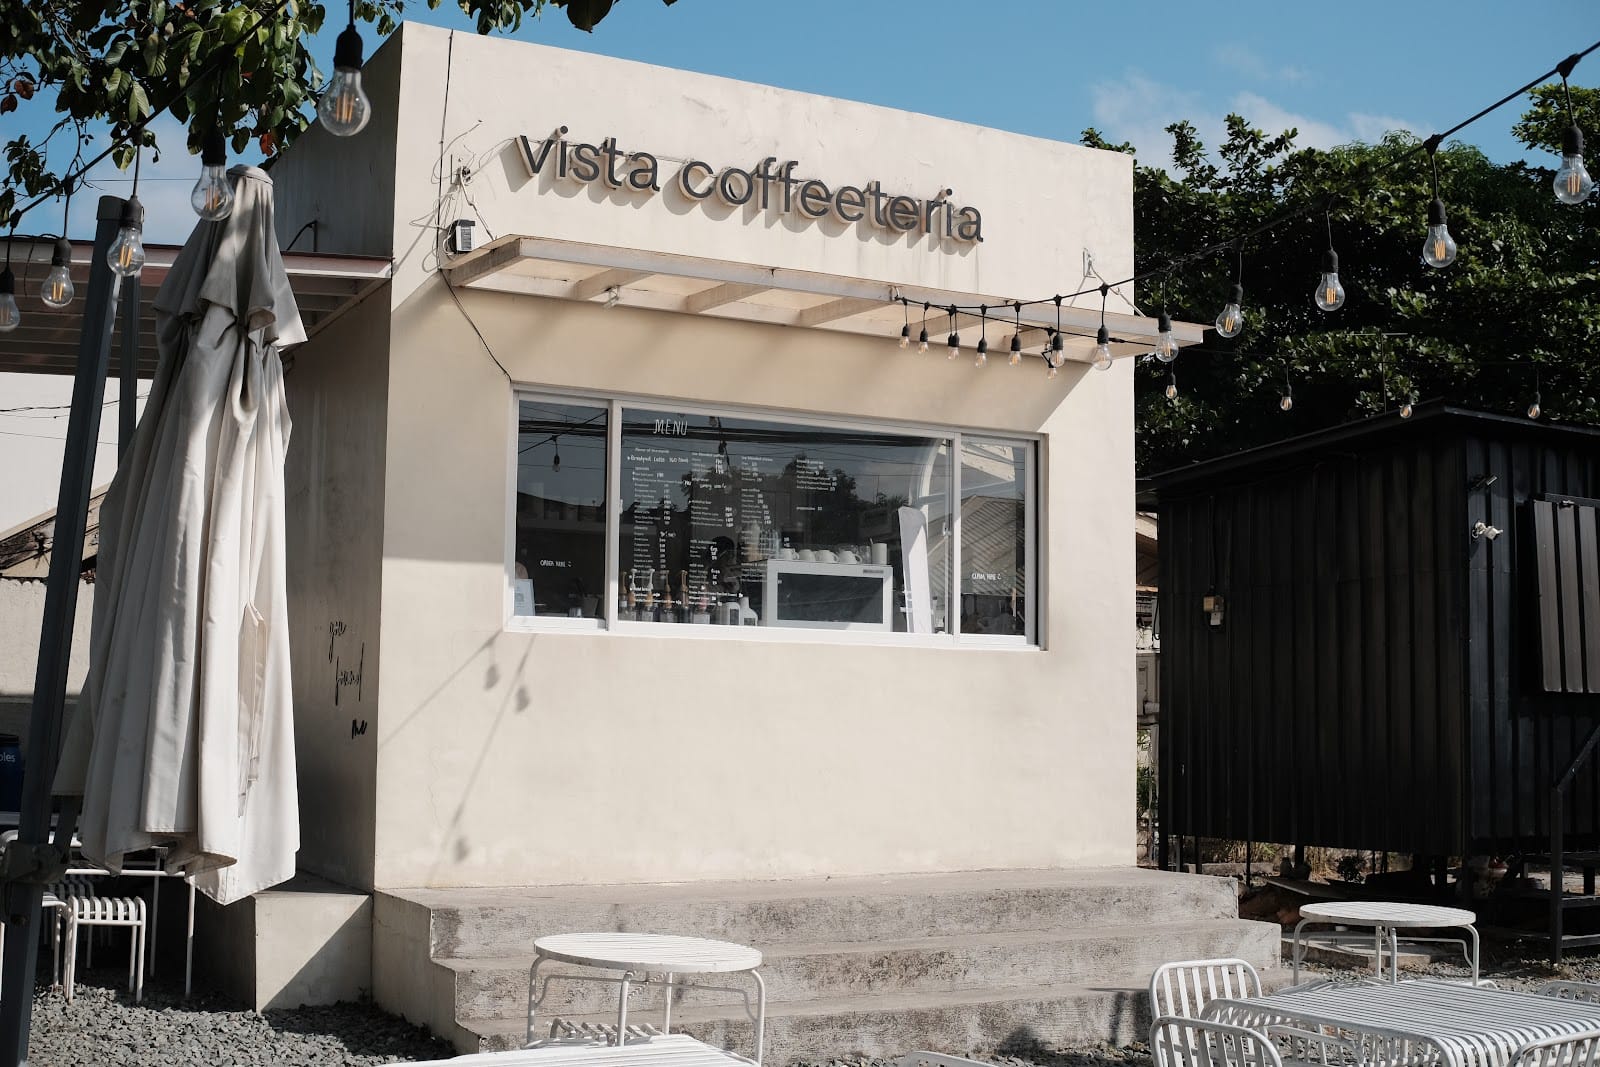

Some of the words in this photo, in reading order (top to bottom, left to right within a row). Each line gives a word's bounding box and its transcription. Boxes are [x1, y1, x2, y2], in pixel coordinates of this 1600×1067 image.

[518, 125, 660, 192] vista
[681, 156, 984, 243] coffeeteria
[653, 419, 688, 436] MENU
